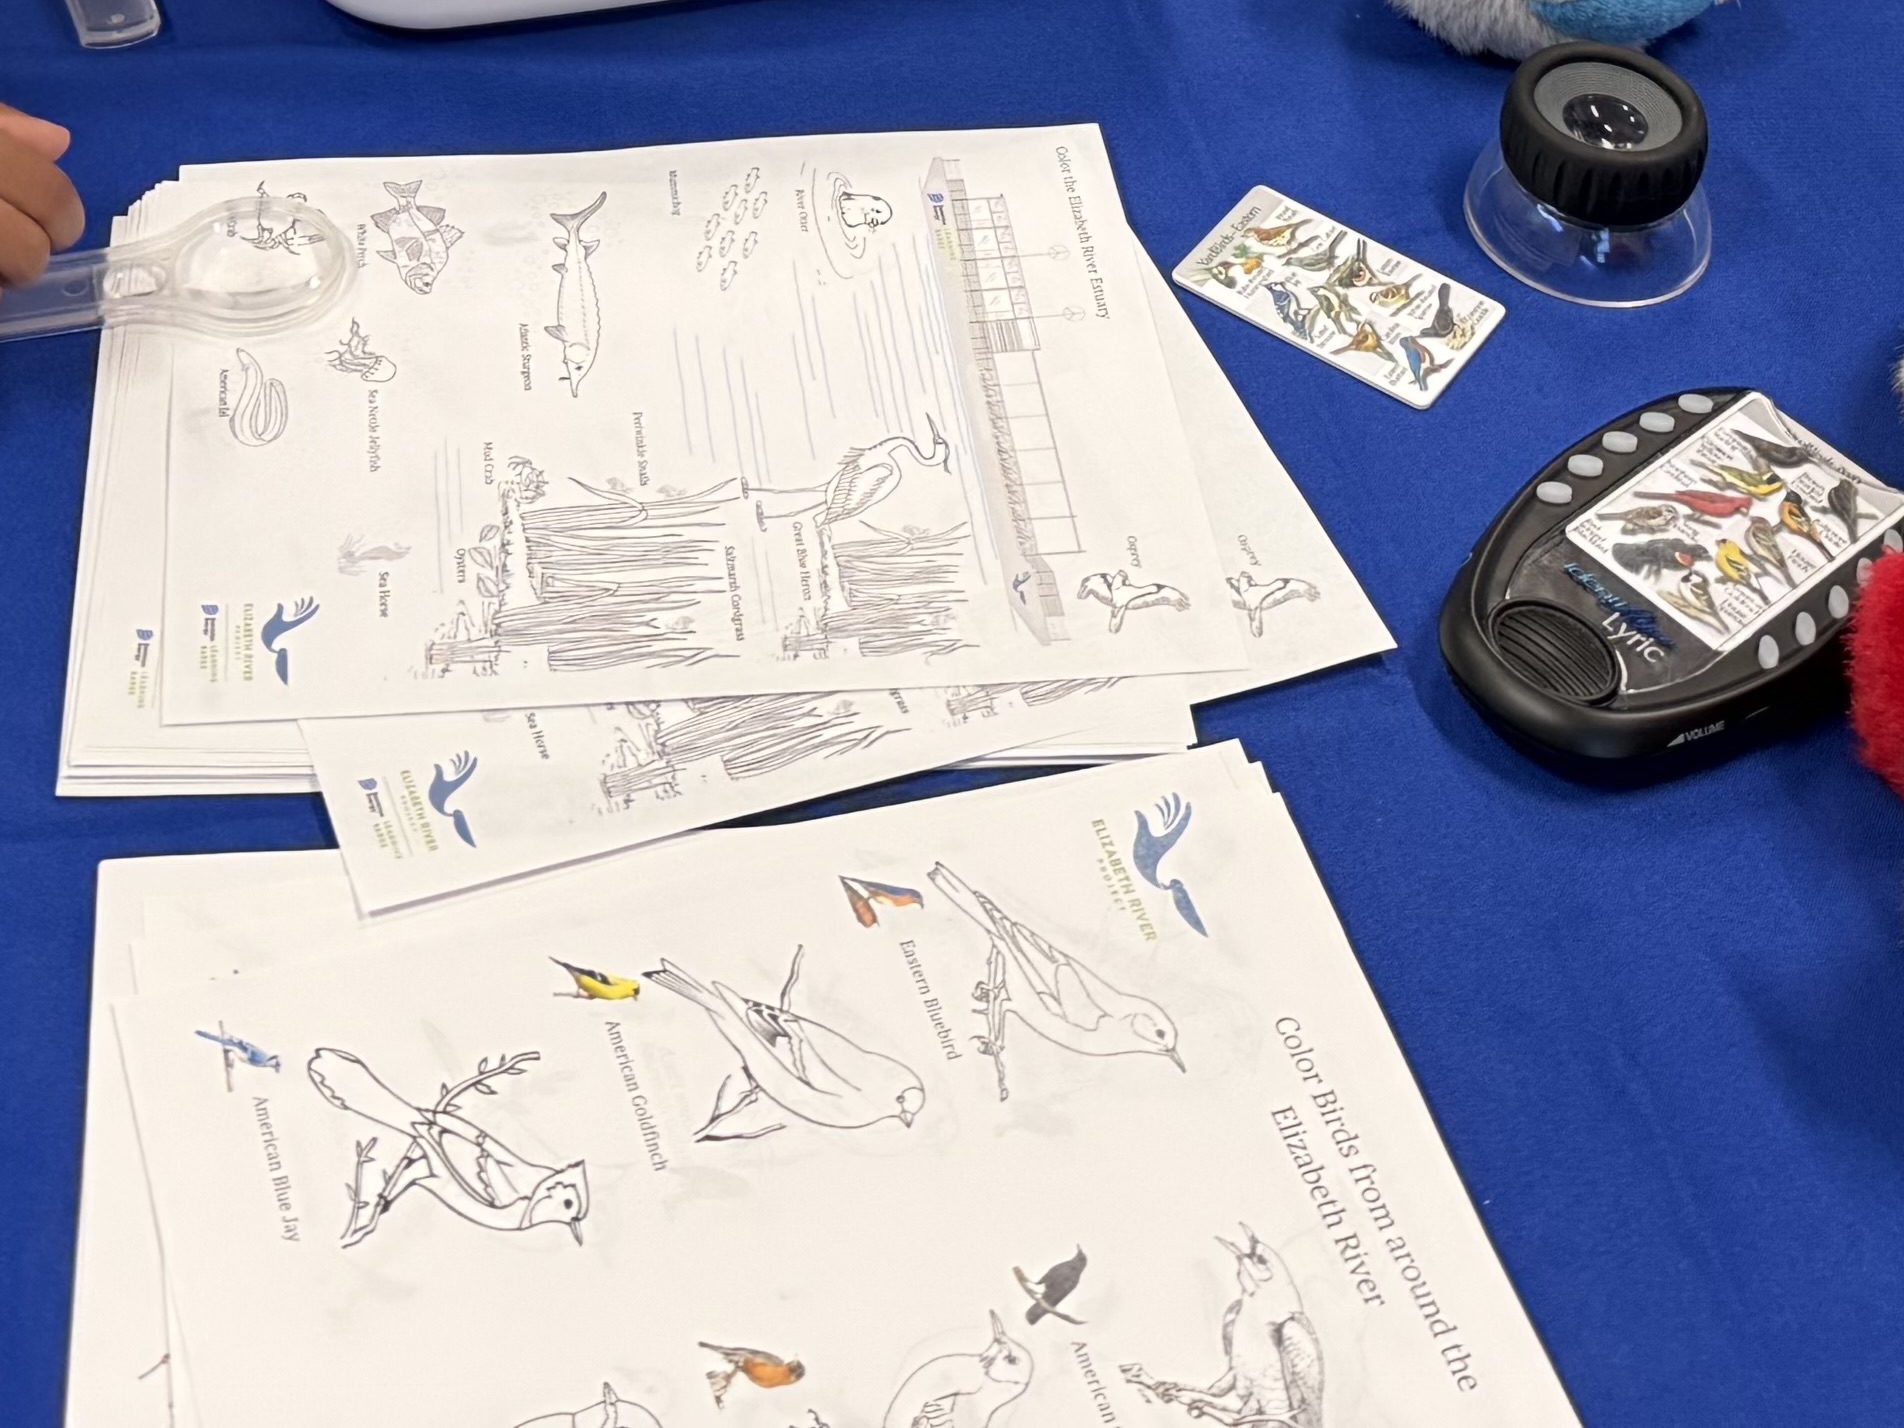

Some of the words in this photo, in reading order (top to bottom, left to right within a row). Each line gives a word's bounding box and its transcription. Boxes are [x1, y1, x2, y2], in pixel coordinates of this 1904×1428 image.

[1054, 146, 1071, 175] Color
[1063, 175, 1076, 194] the
[1068, 194, 1093, 244] Elizabeth
[1080, 245, 1098, 275] River
[1090, 277, 1111, 320] Estuary
[377, 570, 391, 589] Sea
[1600, 610, 1666, 663] Lyric
[523, 711, 539, 731] Sea
[1684, 719, 1726, 742] VOLUME
[1091, 818, 1137, 895] ELIZABETH
[1127, 897, 1159, 942] RIVER
[899, 939, 931, 996] Eastern
[923, 997, 964, 1061] Bluebird
[604, 1020, 640, 1093] American
[631, 1094, 669, 1173] Goldfinch
[251, 1096, 282, 1173] American
[271, 1174, 293, 1212] Blue
[1270, 1104, 1347, 1231] Elizabeth
[1333, 1231, 1386, 1307] River
[1274, 1015, 1323, 1086] Color
[1310, 1087, 1360, 1159] Birds
[1348, 1162, 1396, 1233] from
[1385, 1235, 1458, 1340] around
[1440, 1342, 1478, 1394] the
[280, 1215, 301, 1243] Jay
[1070, 1340, 1117, 1425] American
